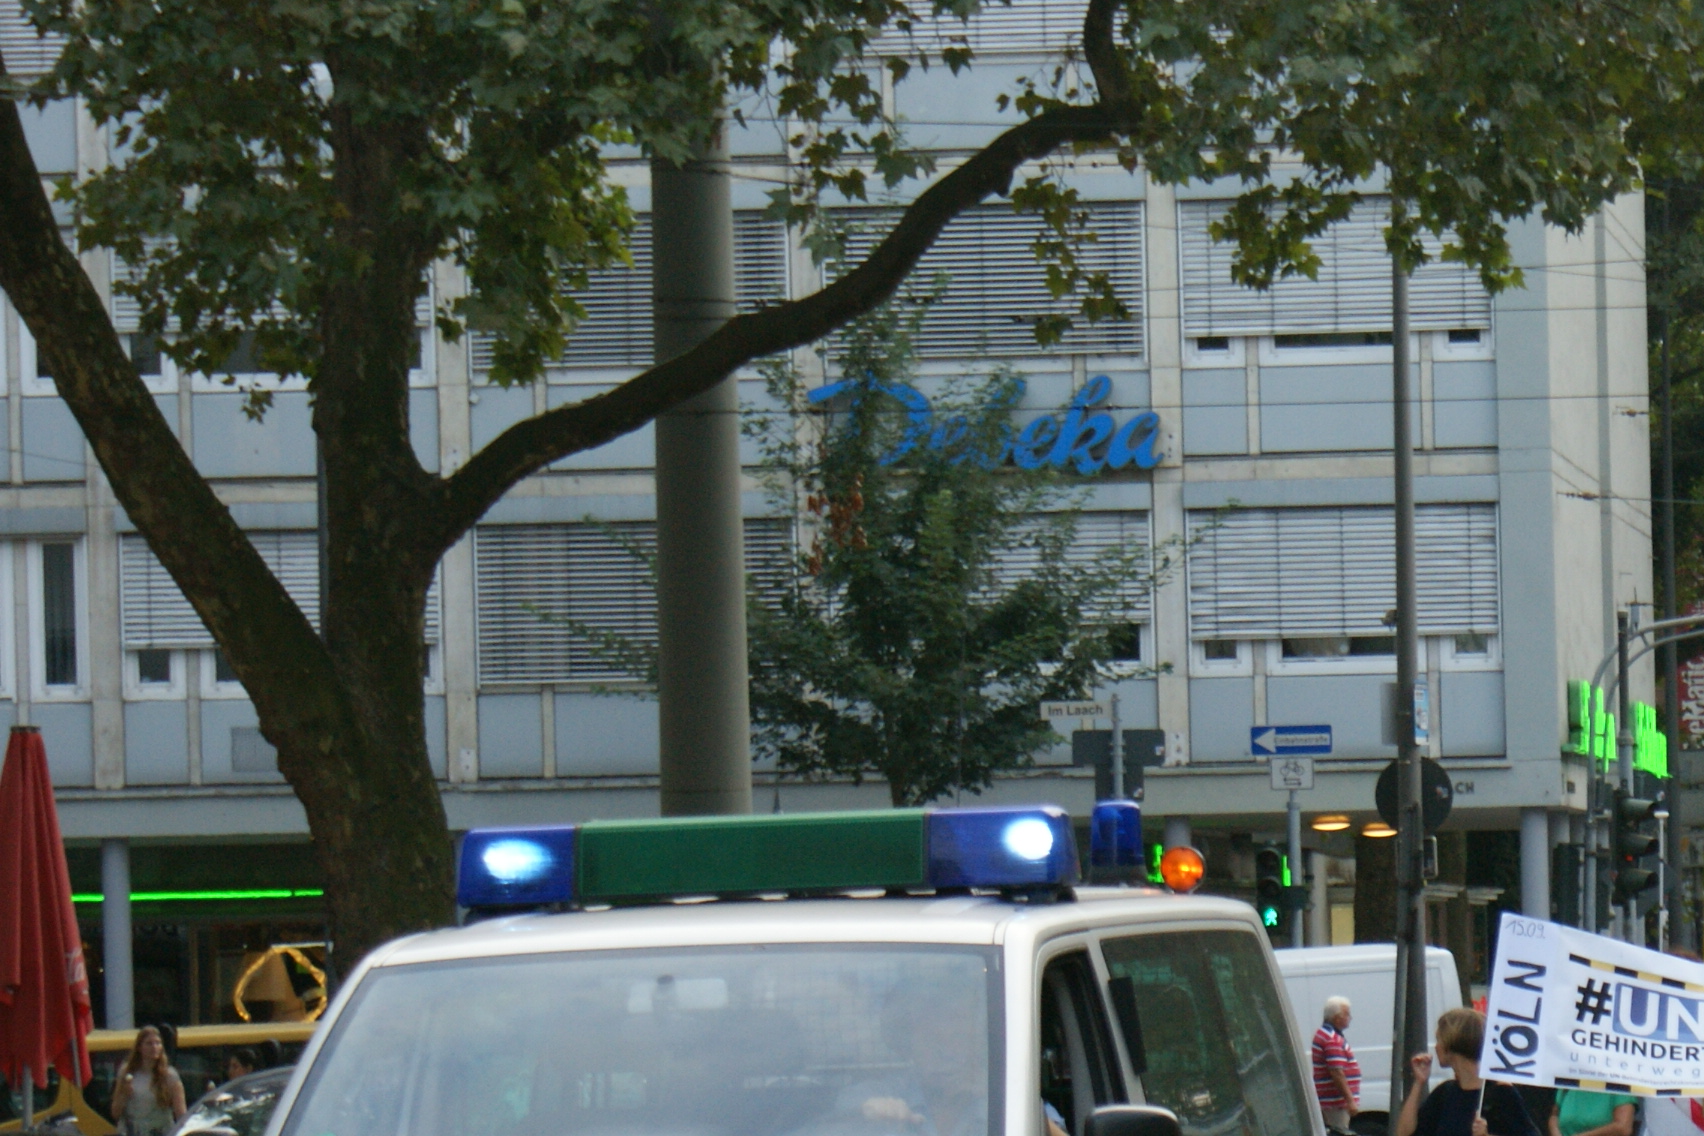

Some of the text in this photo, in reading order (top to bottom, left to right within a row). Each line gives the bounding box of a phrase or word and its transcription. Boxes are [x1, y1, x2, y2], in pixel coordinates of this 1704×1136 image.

[1047, 704, 1104, 716] Im Laach
[1489, 959, 1547, 1078] KÖLN
